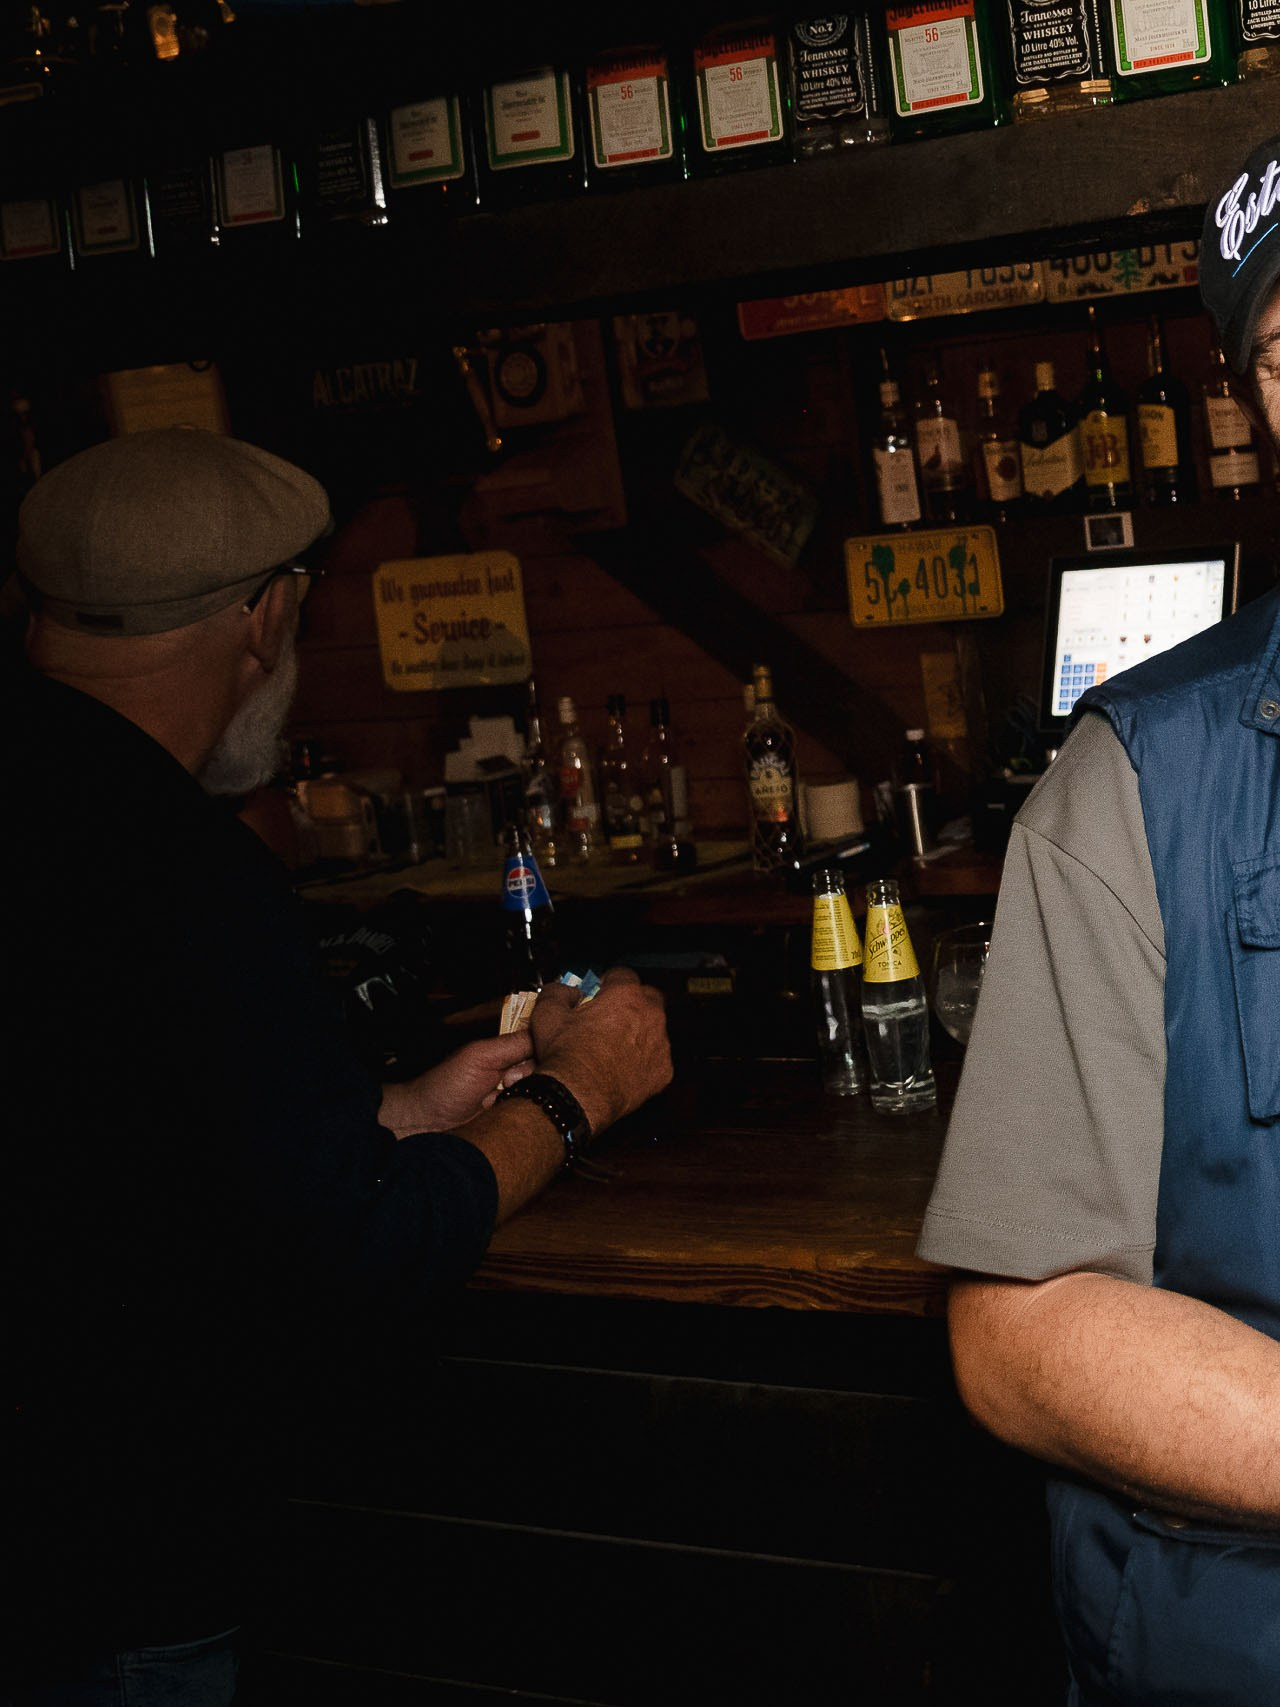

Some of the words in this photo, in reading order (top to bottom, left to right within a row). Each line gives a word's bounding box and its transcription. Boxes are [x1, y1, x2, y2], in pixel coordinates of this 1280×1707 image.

[1020, 8, 1073, 24] Tennessee
[925, 27, 939, 43] 56
[1022, 23, 1073, 40] WHISKEY
[1031, 41, 1047, 52] Litre
[1049, 38, 1064, 49] 40%
[1065, 35, 1079, 46] Vol.
[800, 48, 849, 63] Tennessee
[729, 67, 743, 82] 56
[801, 64, 849, 80] WHISKEY
[620, 85, 634, 100] 56
[413, 610, 492, 645] Service
[509, 878, 535, 888] PESI
[869, 928, 906, 957] Schwppes
